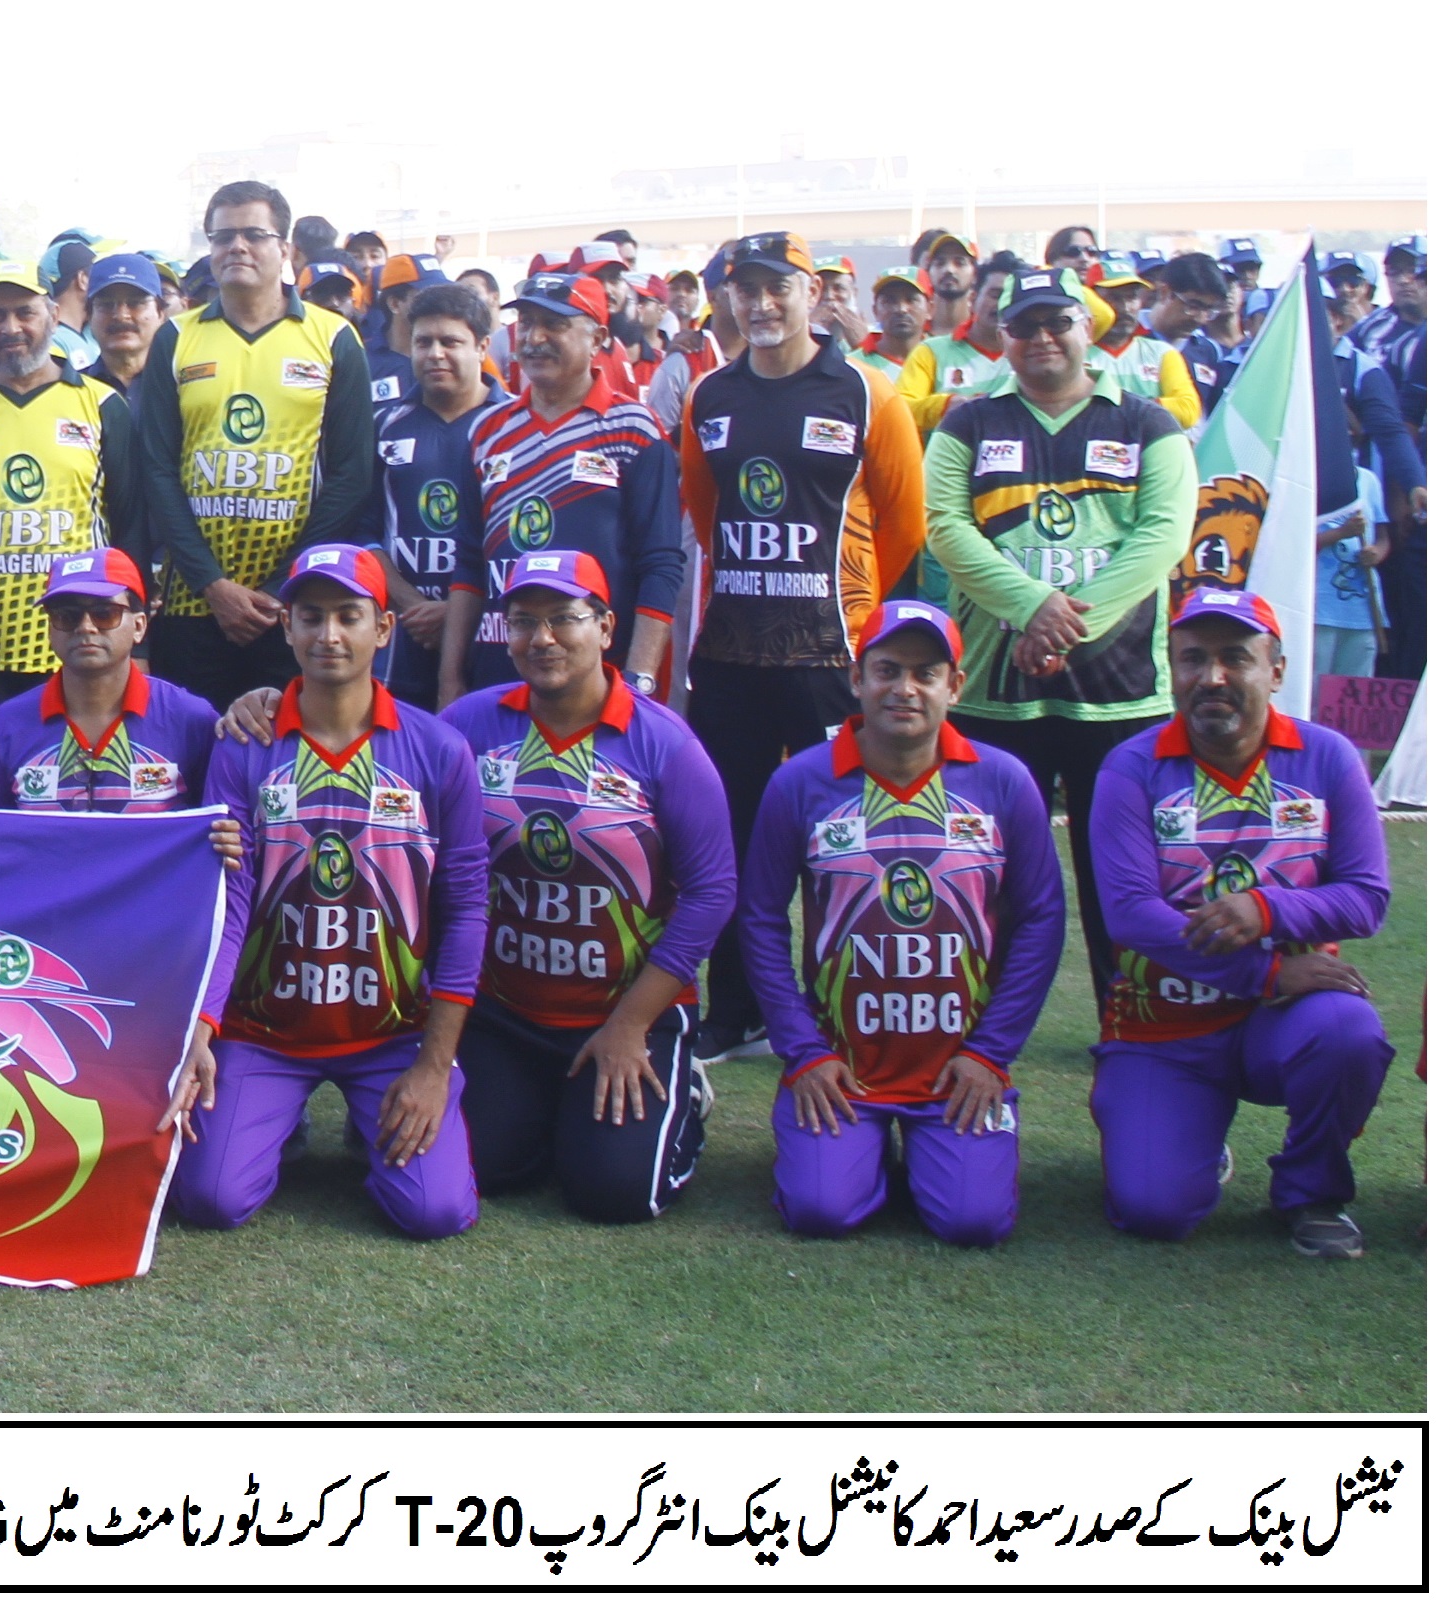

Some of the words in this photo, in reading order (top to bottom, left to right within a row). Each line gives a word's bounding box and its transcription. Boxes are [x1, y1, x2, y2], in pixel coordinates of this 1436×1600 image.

[193, 450, 293, 490] NBP
[720, 521, 818, 563] NBP
[764, 571, 829, 599] WARRIORS
[494, 872, 612, 927] NBP
[280, 904, 380, 953] NBP
[494, 925, 607, 979] CRBG
[850, 932, 964, 979] NBP
[274, 961, 379, 1007] CRBG
[856, 991, 962, 1035] CRBG
